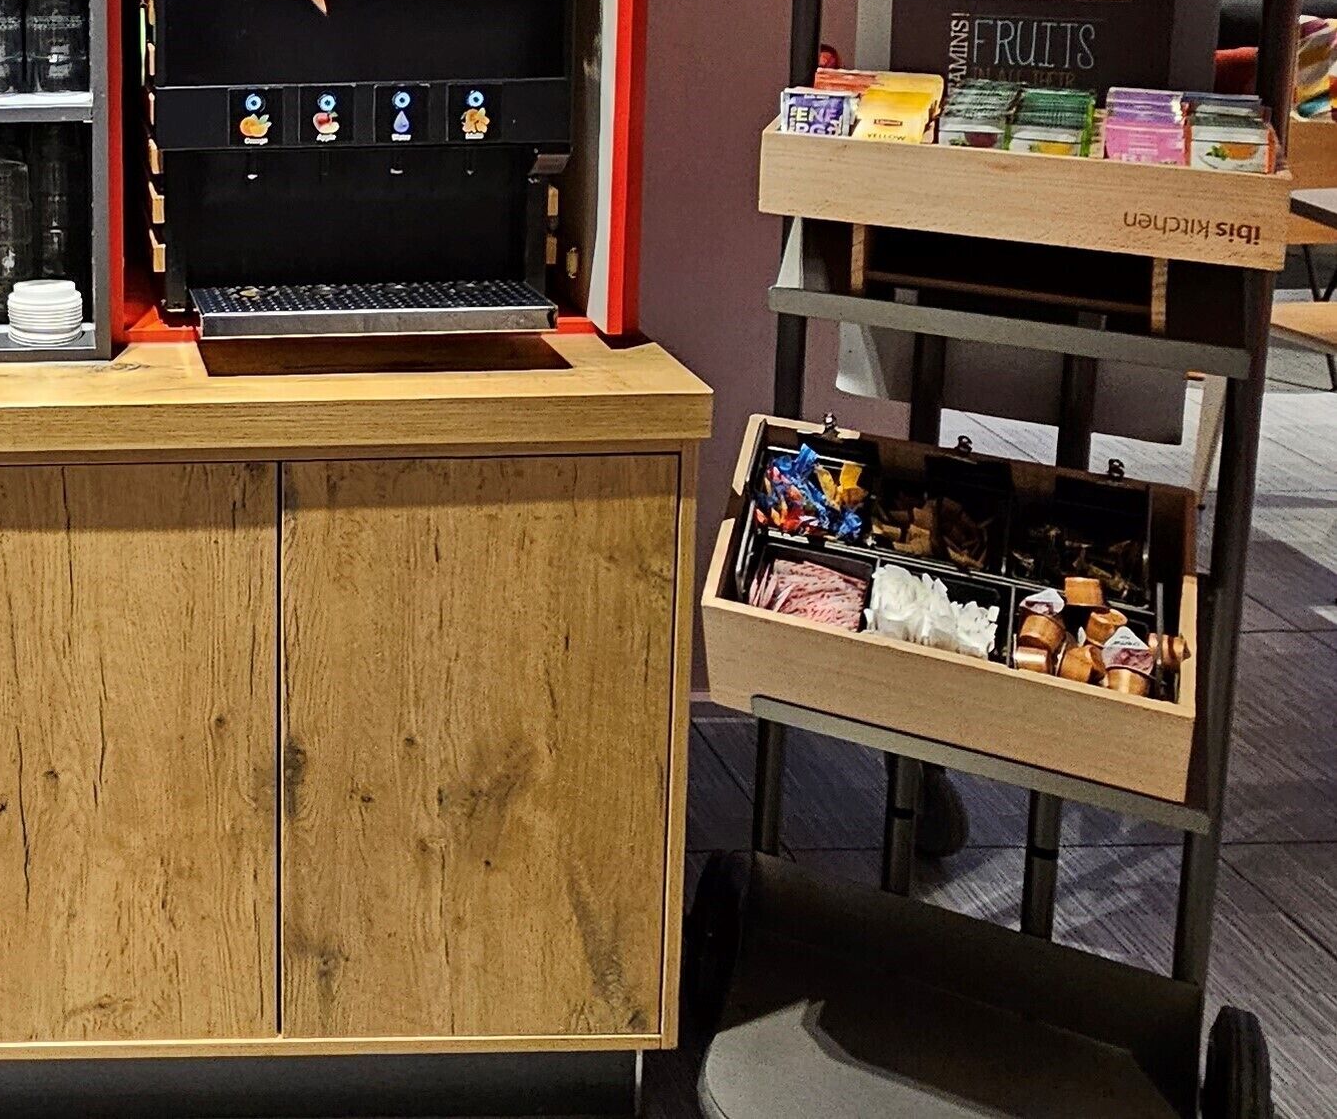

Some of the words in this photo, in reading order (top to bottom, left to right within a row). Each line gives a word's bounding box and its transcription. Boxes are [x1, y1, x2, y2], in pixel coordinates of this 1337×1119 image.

[972, 19, 1096, 70] FRUITS
[1123, 211, 1211, 240] kitchen
[1215, 221, 1261, 246] ibis
